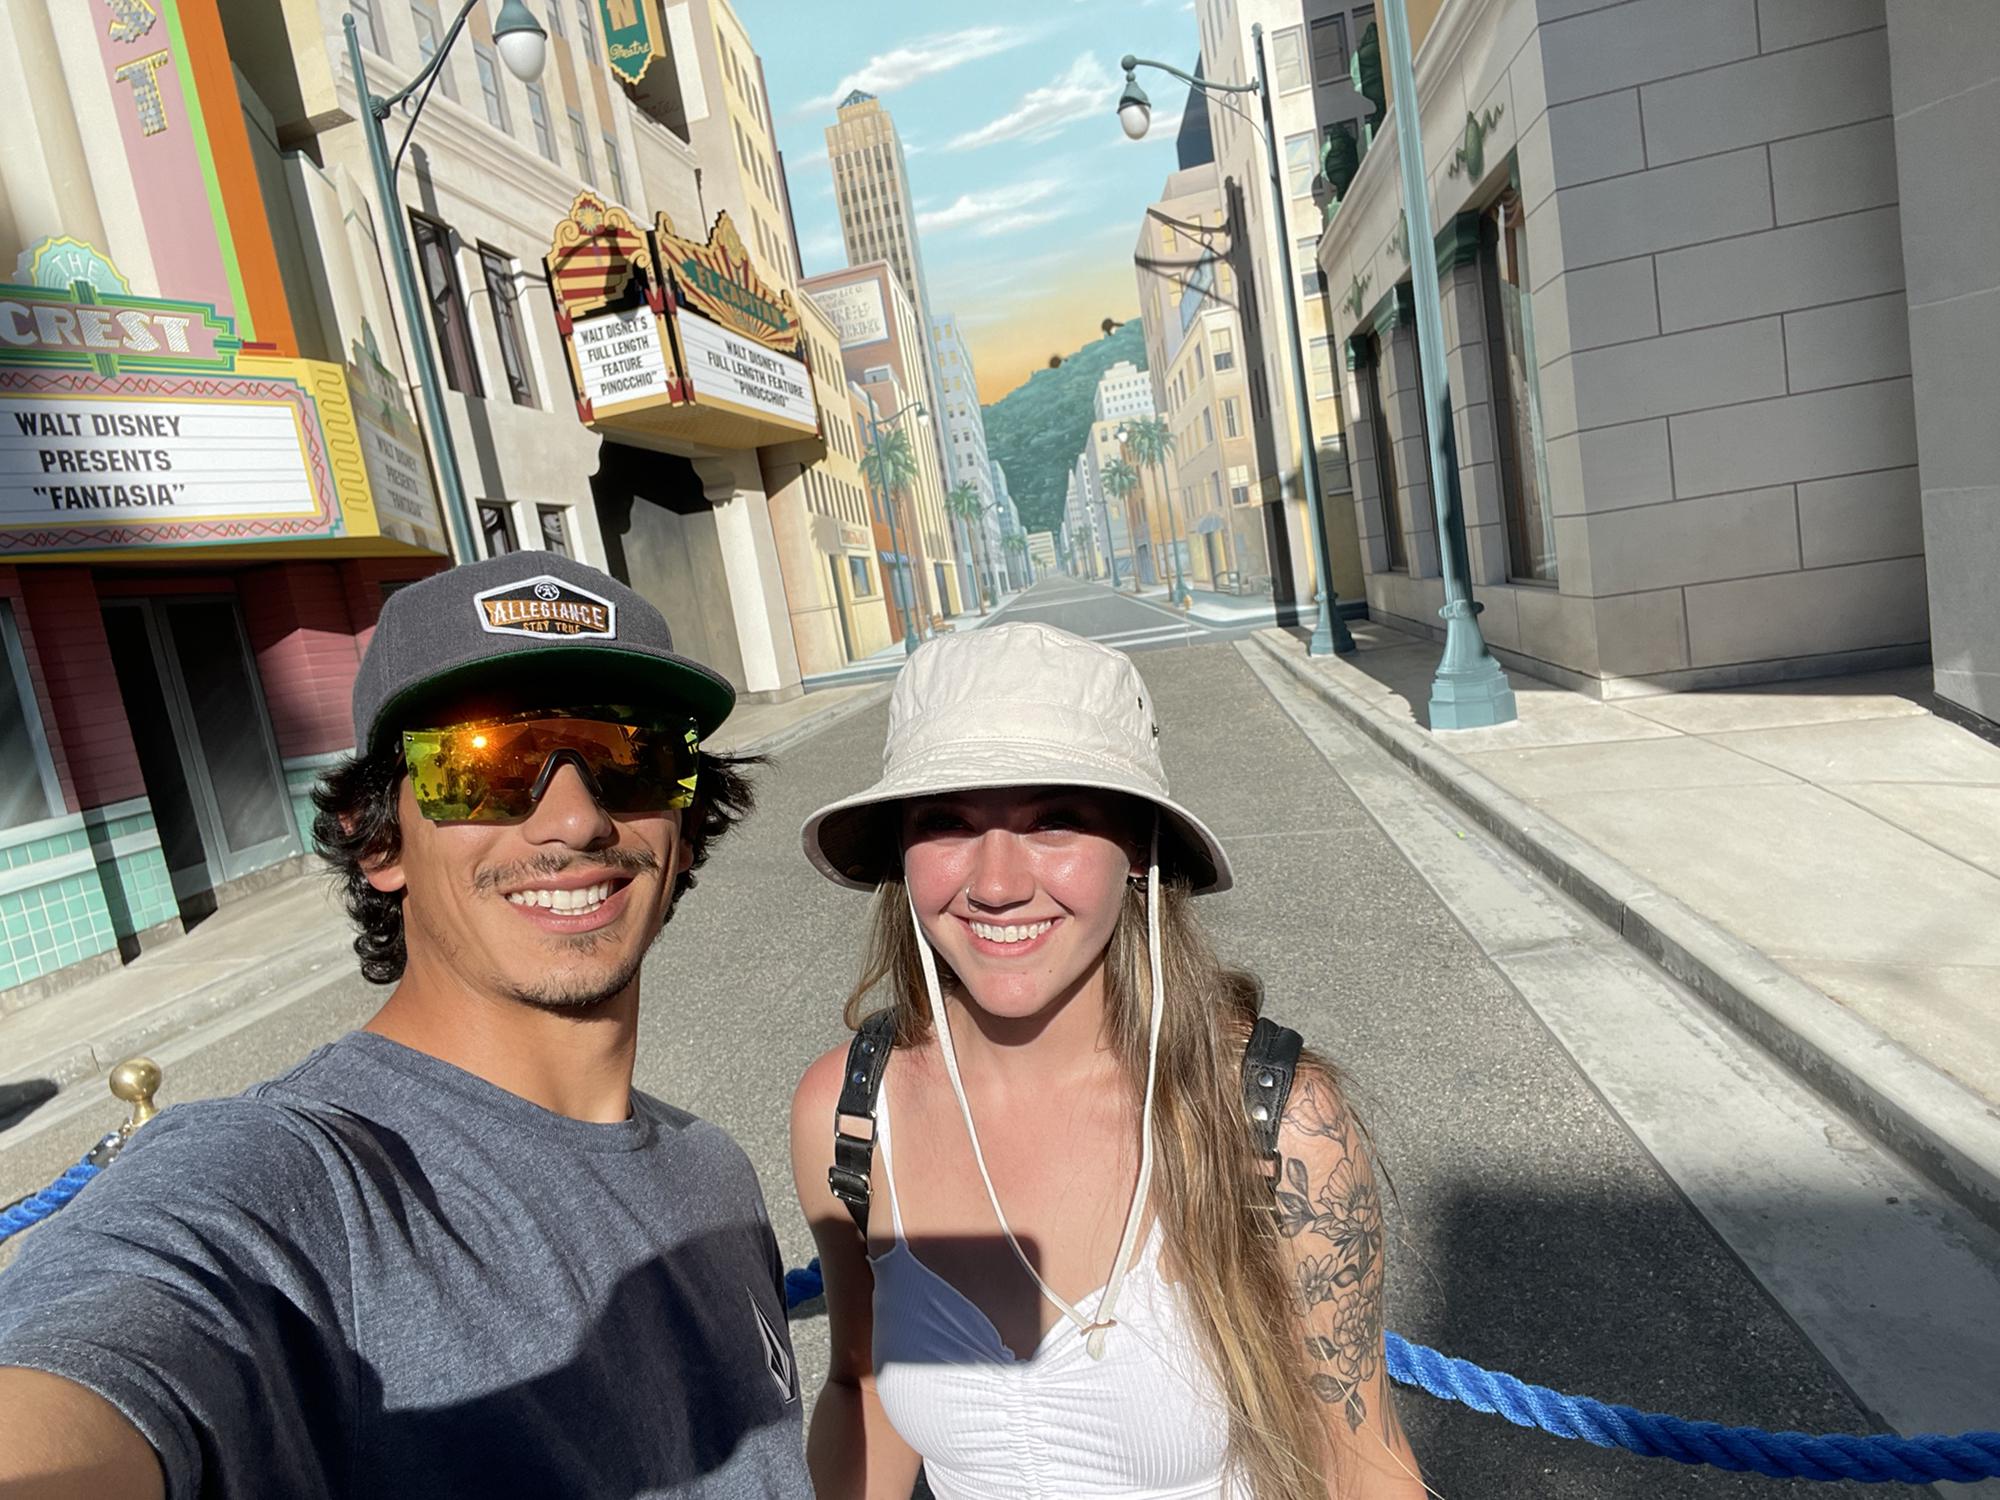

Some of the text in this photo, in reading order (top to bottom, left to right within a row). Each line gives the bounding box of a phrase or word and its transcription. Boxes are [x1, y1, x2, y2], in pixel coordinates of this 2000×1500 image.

[52, 252, 100, 280] THE
[696, 263, 717, 293] EL
[0, 300, 191, 353] CREST
[580, 316, 648, 345] WALT DISNEY'S
[587, 335, 650, 363] FULL LENGTH
[724, 339, 786, 376] WALT DISNEY'S
[601, 355, 644, 377] FEATURE
[707, 351, 805, 399] FULL LENGTH FEATURE
[734, 379, 790, 408] "PINOCCHIO"
[14, 412, 181, 437] WALT DISNEY
[39, 449, 173, 473] PRESENTS
[33, 483, 185, 510] "FANTASIA"
[493, 601, 606, 629] ALLEGIANCE
[522, 621, 582, 634] STAY TRUE
